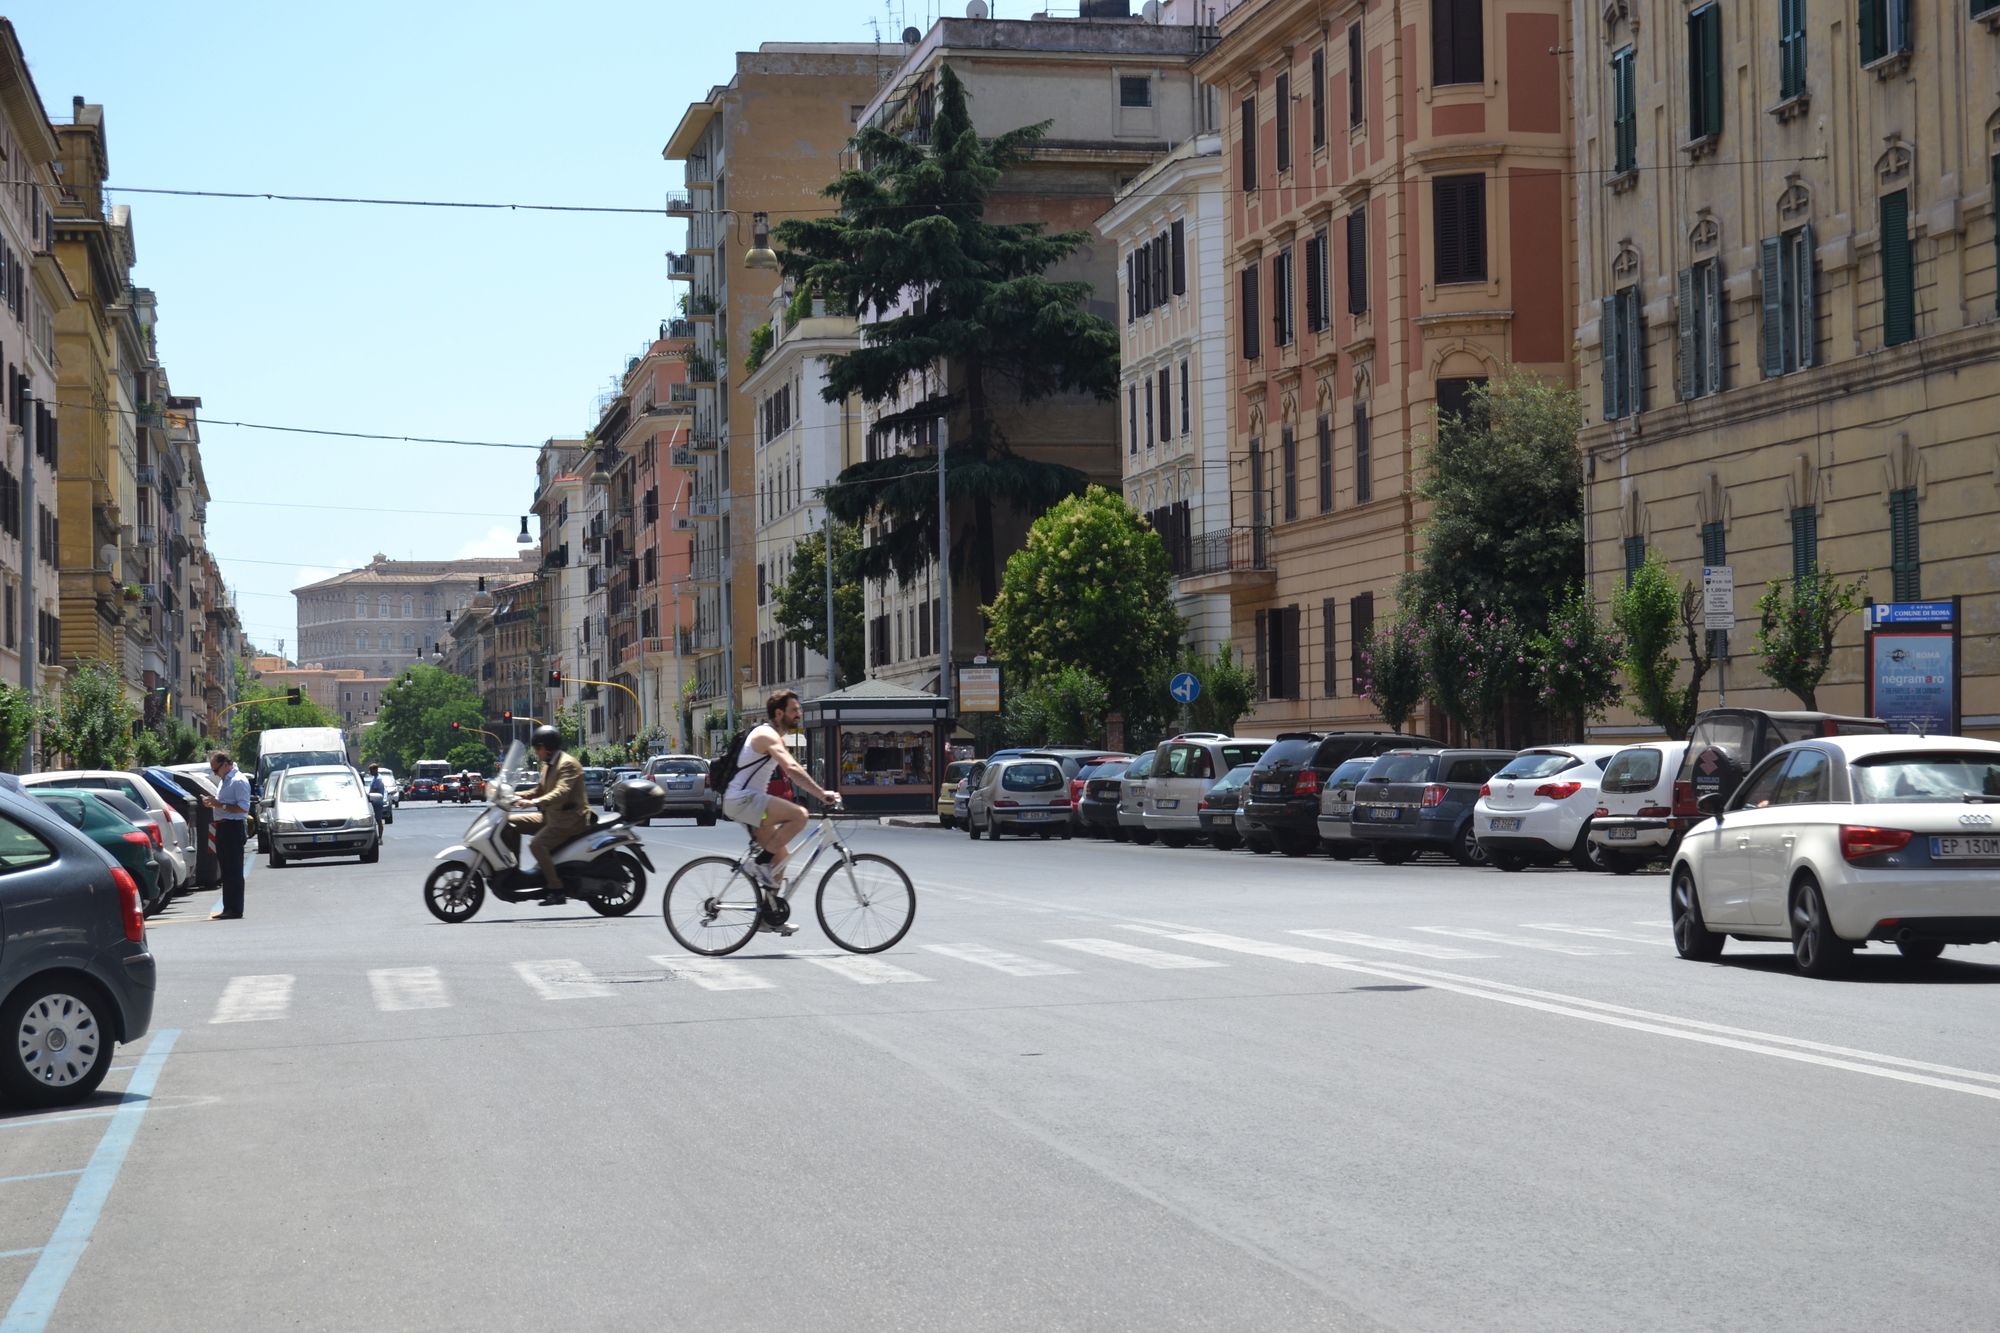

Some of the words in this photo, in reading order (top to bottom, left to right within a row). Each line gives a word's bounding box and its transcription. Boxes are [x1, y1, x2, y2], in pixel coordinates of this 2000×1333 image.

[1876, 604, 1889, 622] P
[1881, 675, 1945, 687] negramaro
[1942, 839, 1959, 854] EP
